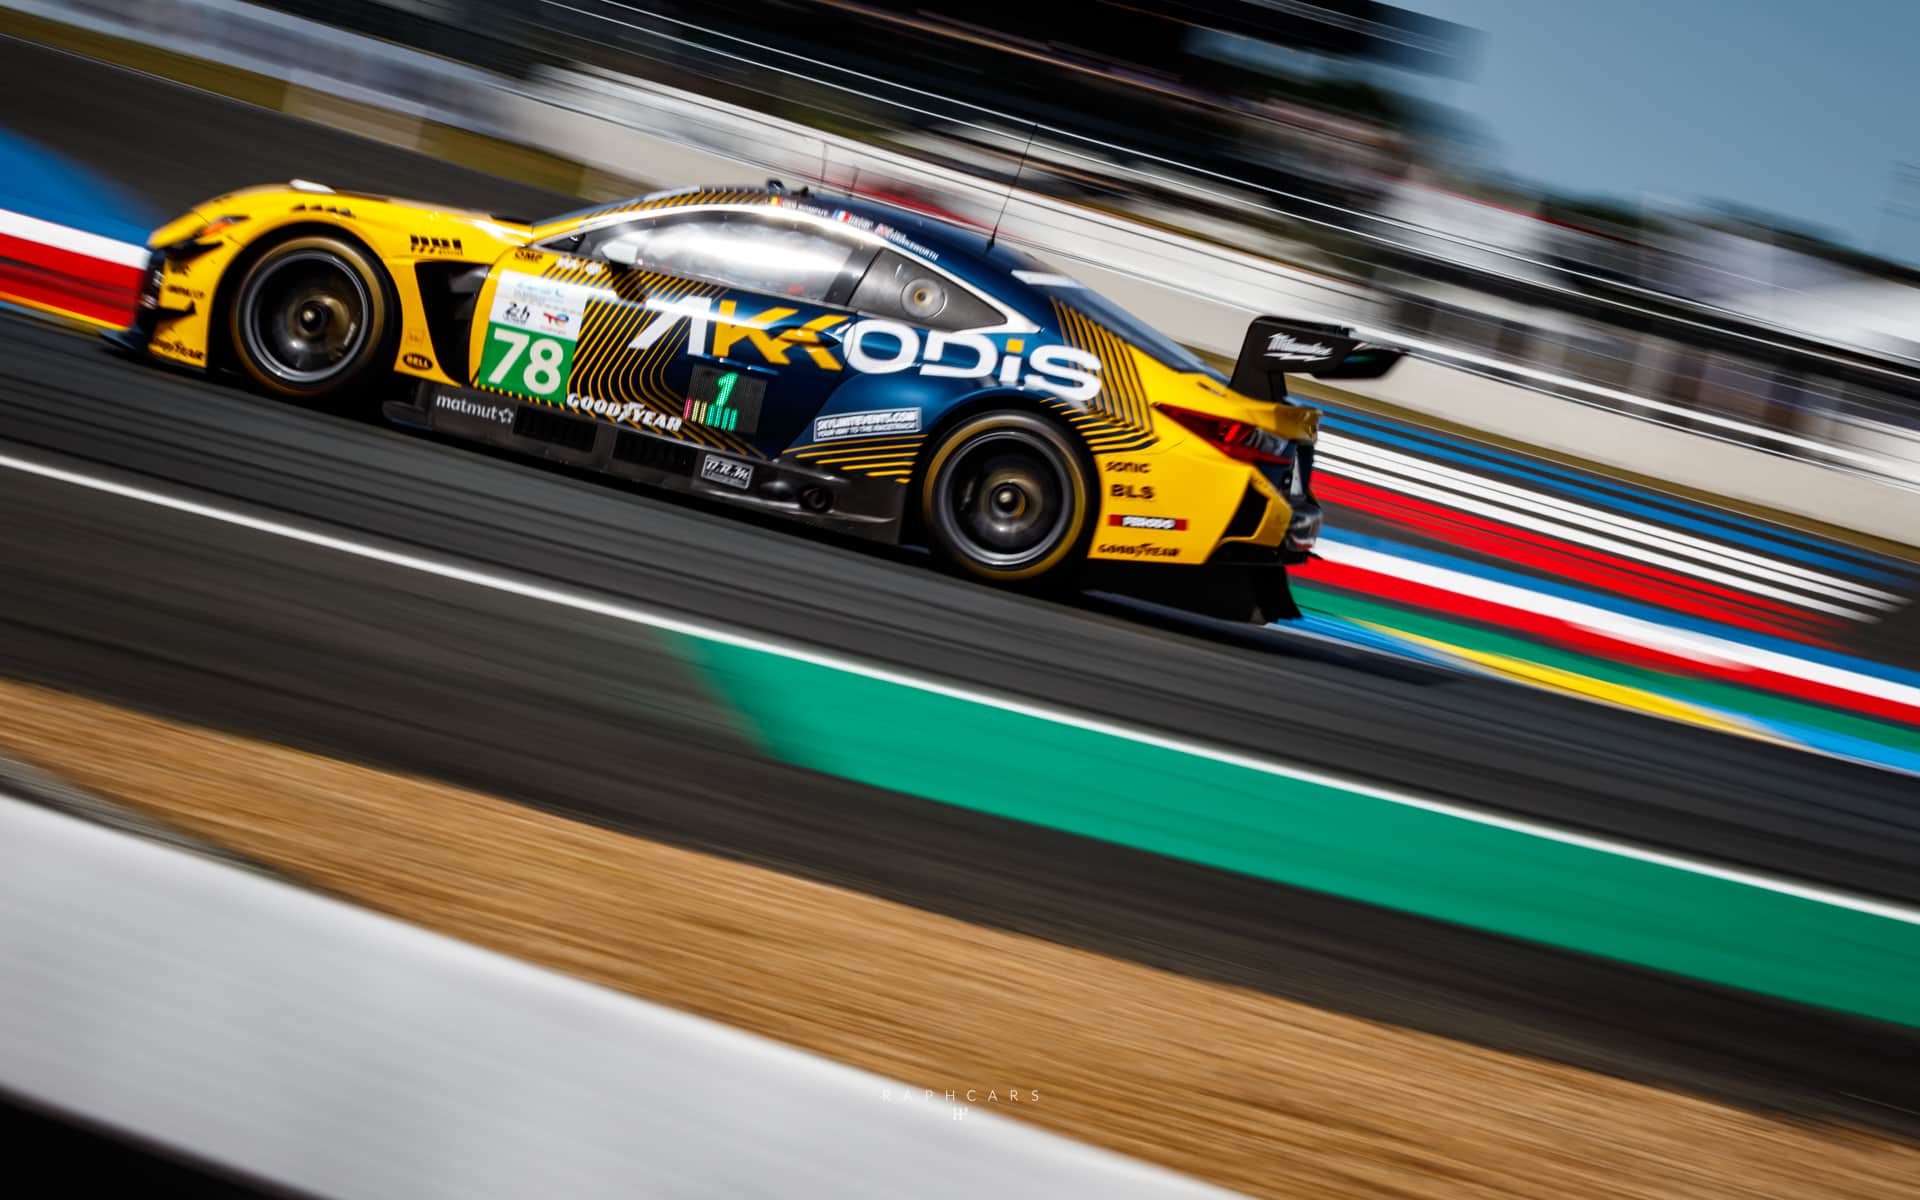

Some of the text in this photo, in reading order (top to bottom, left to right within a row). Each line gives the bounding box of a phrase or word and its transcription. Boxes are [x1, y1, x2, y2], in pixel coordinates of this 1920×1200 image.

[488, 327, 564, 395] 78
[436, 394, 498, 420] matmut
[716, 371, 739, 407] 1
[566, 392, 682, 432] GOODYEAR
[1110, 484, 1154, 500] BLS
